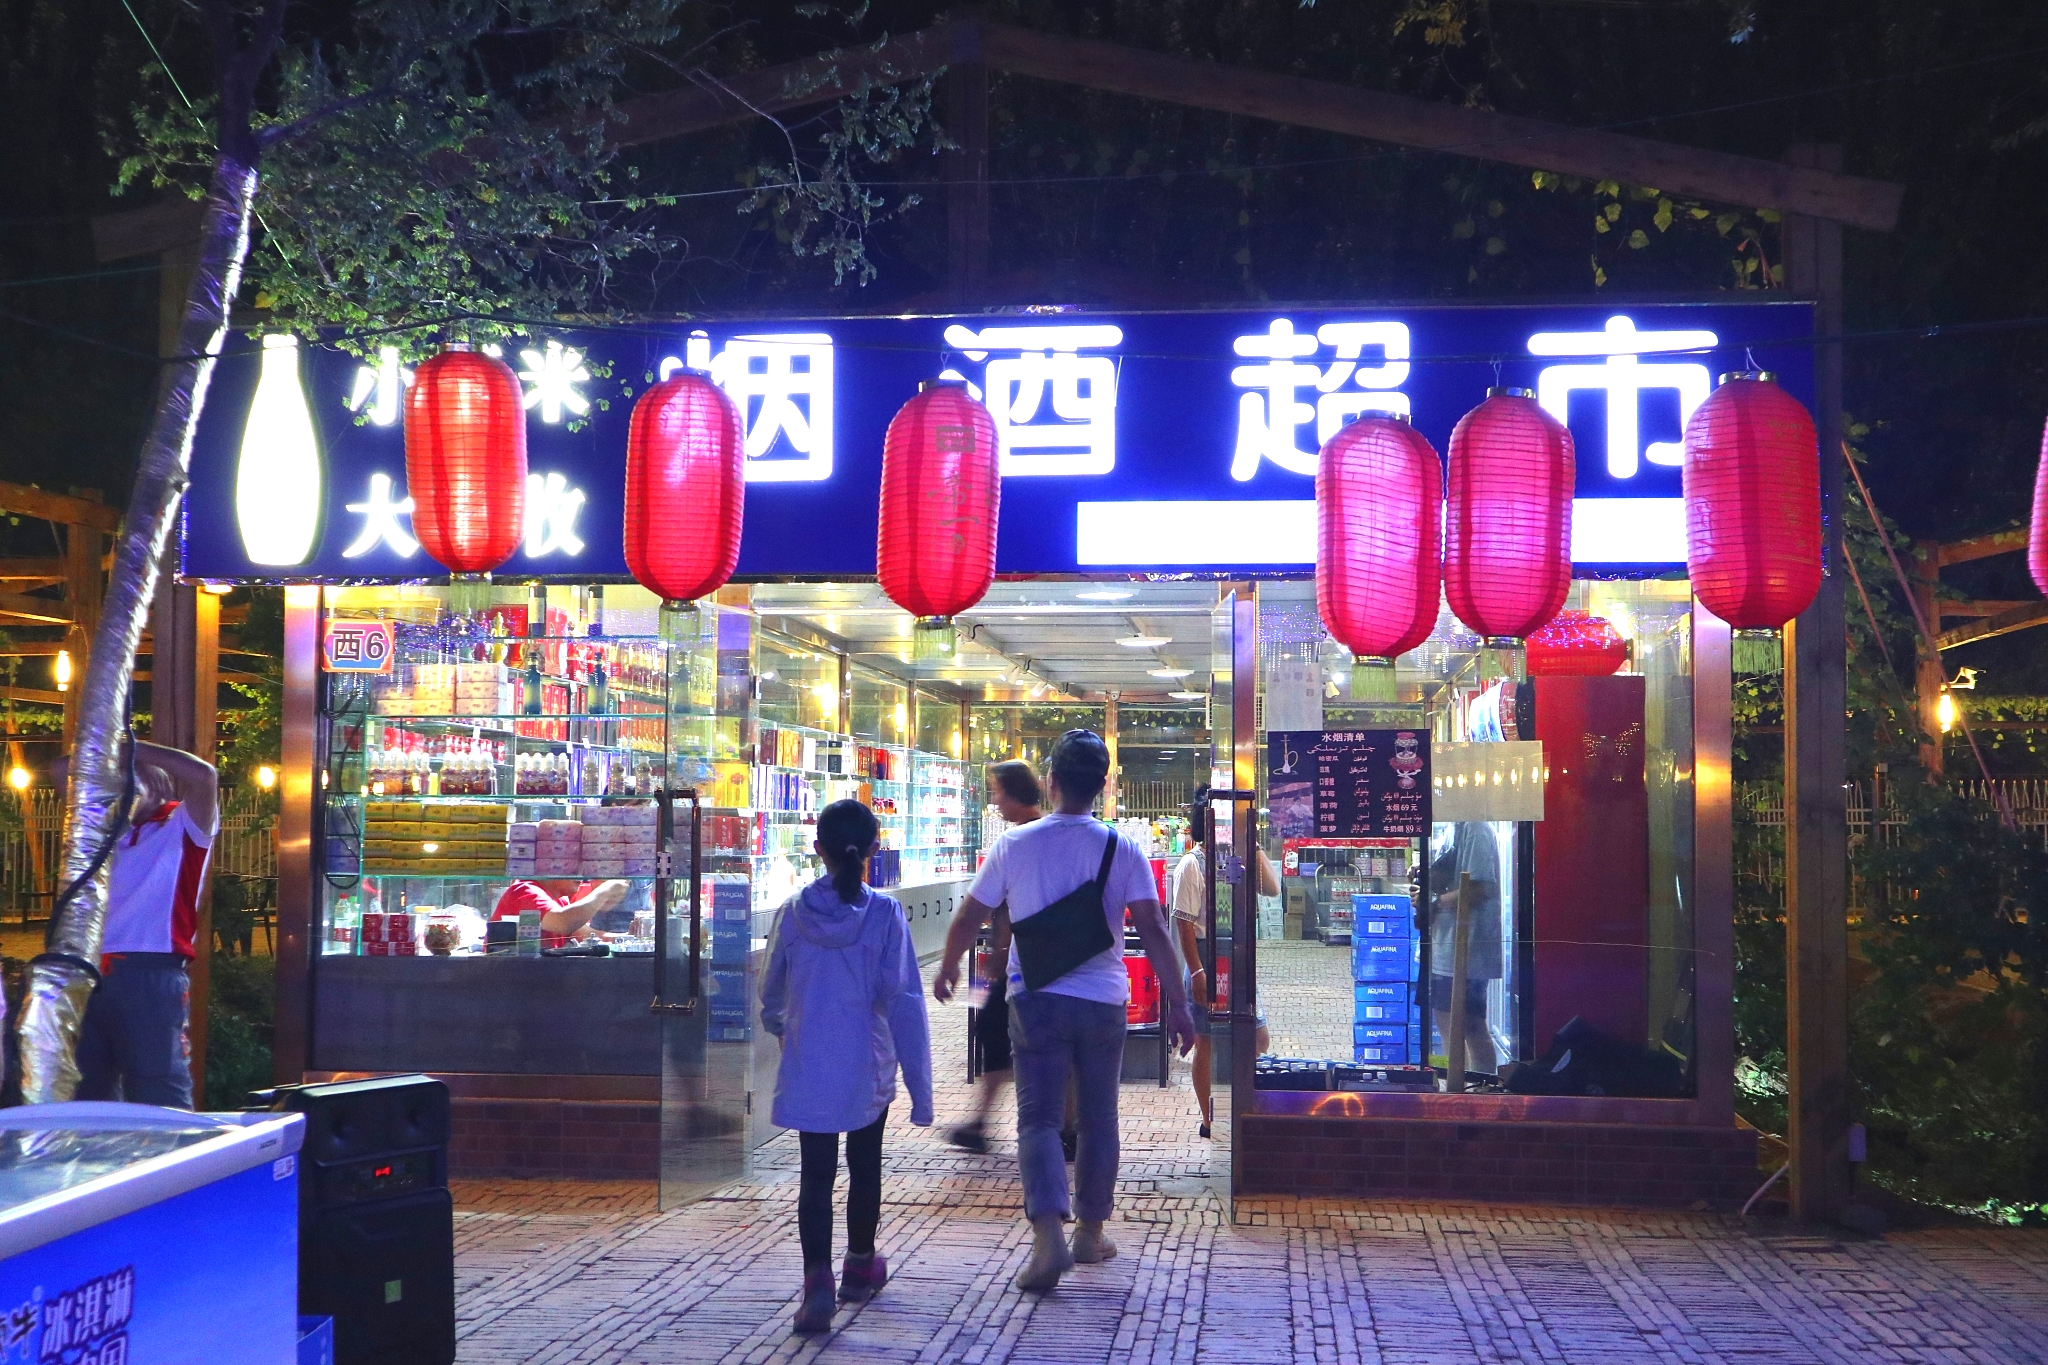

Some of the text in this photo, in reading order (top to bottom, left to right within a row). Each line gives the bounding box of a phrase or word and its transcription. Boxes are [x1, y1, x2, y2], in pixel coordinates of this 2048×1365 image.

[350, 341, 590, 425] 小米
[331, 629, 386, 662] 西6
[1321, 732, 1366, 742] 水烟清单
[1385, 803, 1400, 811] 水烟
[1410, 803, 1418, 811] 元
[1405, 824, 1415, 834] 89
[1415, 825, 1423, 833] 元
[1369, 903, 1397, 911] AQUAFINA
[1370, 945, 1398, 953] AQUAFINA
[1367, 987, 1394, 995] AQUAFINA
[1366, 1030, 1393, 1038] AQUAFINA
[41, 1266, 133, 1359] 冰淇淋
